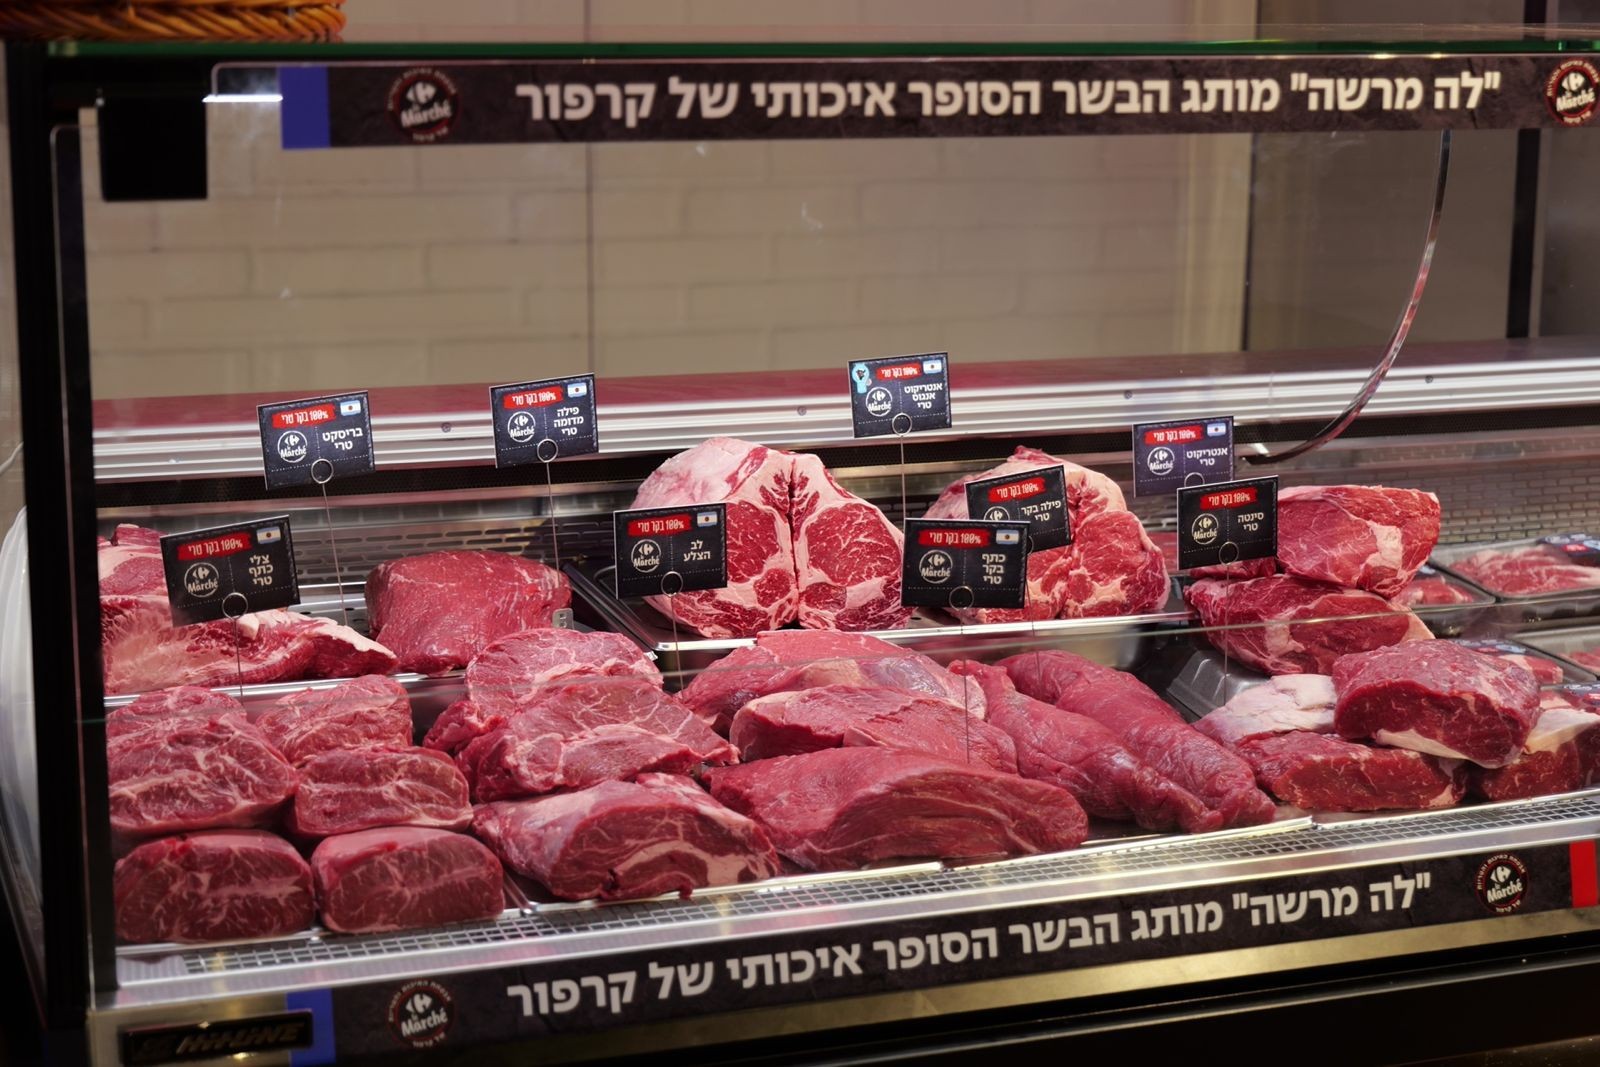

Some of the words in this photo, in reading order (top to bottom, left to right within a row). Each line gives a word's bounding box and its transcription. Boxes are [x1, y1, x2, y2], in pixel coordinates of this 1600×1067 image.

[1052, 79, 1170, 114] הבשר
[1181, 78, 1281, 113] מותג
[1290, 72, 1424, 111] מרשה"
[1434, 70, 1501, 110] "לה
[669, 76, 738, 118] של
[751, 82, 896, 117] איכותי
[908, 81, 1041, 116] הסופר
[516, 84, 656, 128] קרפור
[892, 368, 902, 378] בקר
[904, 382, 943, 394] אנטריקוט
[525, 392, 537, 405] בקר
[912, 392, 936, 402] אנגוס
[557, 406, 580, 417] פילה
[917, 401, 932, 409] טרי
[295, 411, 309, 424] בקר
[553, 416, 584, 428] מדומה
[322, 427, 363, 443] בריסקט
[561, 427, 578, 436] טרי
[1166, 431, 1178, 442] בקר
[334, 440, 353, 451] טרי
[1186, 447, 1228, 460] אנטריקוט
[1199, 458, 1215, 466] טרי
[1010, 485, 1022, 498] בקר
[1040, 500, 1062, 512] פילה
[1220, 493, 1233, 506] בקר
[1020, 504, 1039, 516] בקר
[1034, 512, 1050, 521] טרי
[1237, 512, 1264, 523] סינטה
[651, 520, 665, 533] בקר
[1243, 523, 1258, 531] טרי
[690, 539, 704, 550] לב
[944, 532, 959, 545] בקר
[205, 540, 220, 555] בקר
[249, 554, 270, 565] צלי
[683, 551, 711, 562] הצלע
[982, 553, 1007, 564] כתף
[248, 564, 274, 577] כתף
[982, 564, 1005, 575] בקר
[252, 576, 273, 586] טרי
[983, 575, 1002, 585] טרי
[1369, 872, 1431, 912] "לה
[1487, 878, 1523, 903] Marché
[1232, 886, 1359, 926] מרשה"
[1131, 901, 1223, 940] מותג
[1009, 913, 1120, 953] הבשר
[873, 927, 998, 970] הסופר
[726, 944, 862, 988] איכותי
[649, 962, 713, 999] של
[507, 971, 636, 1016] קרפור
[401, 1007, 448, 1037] Marché
